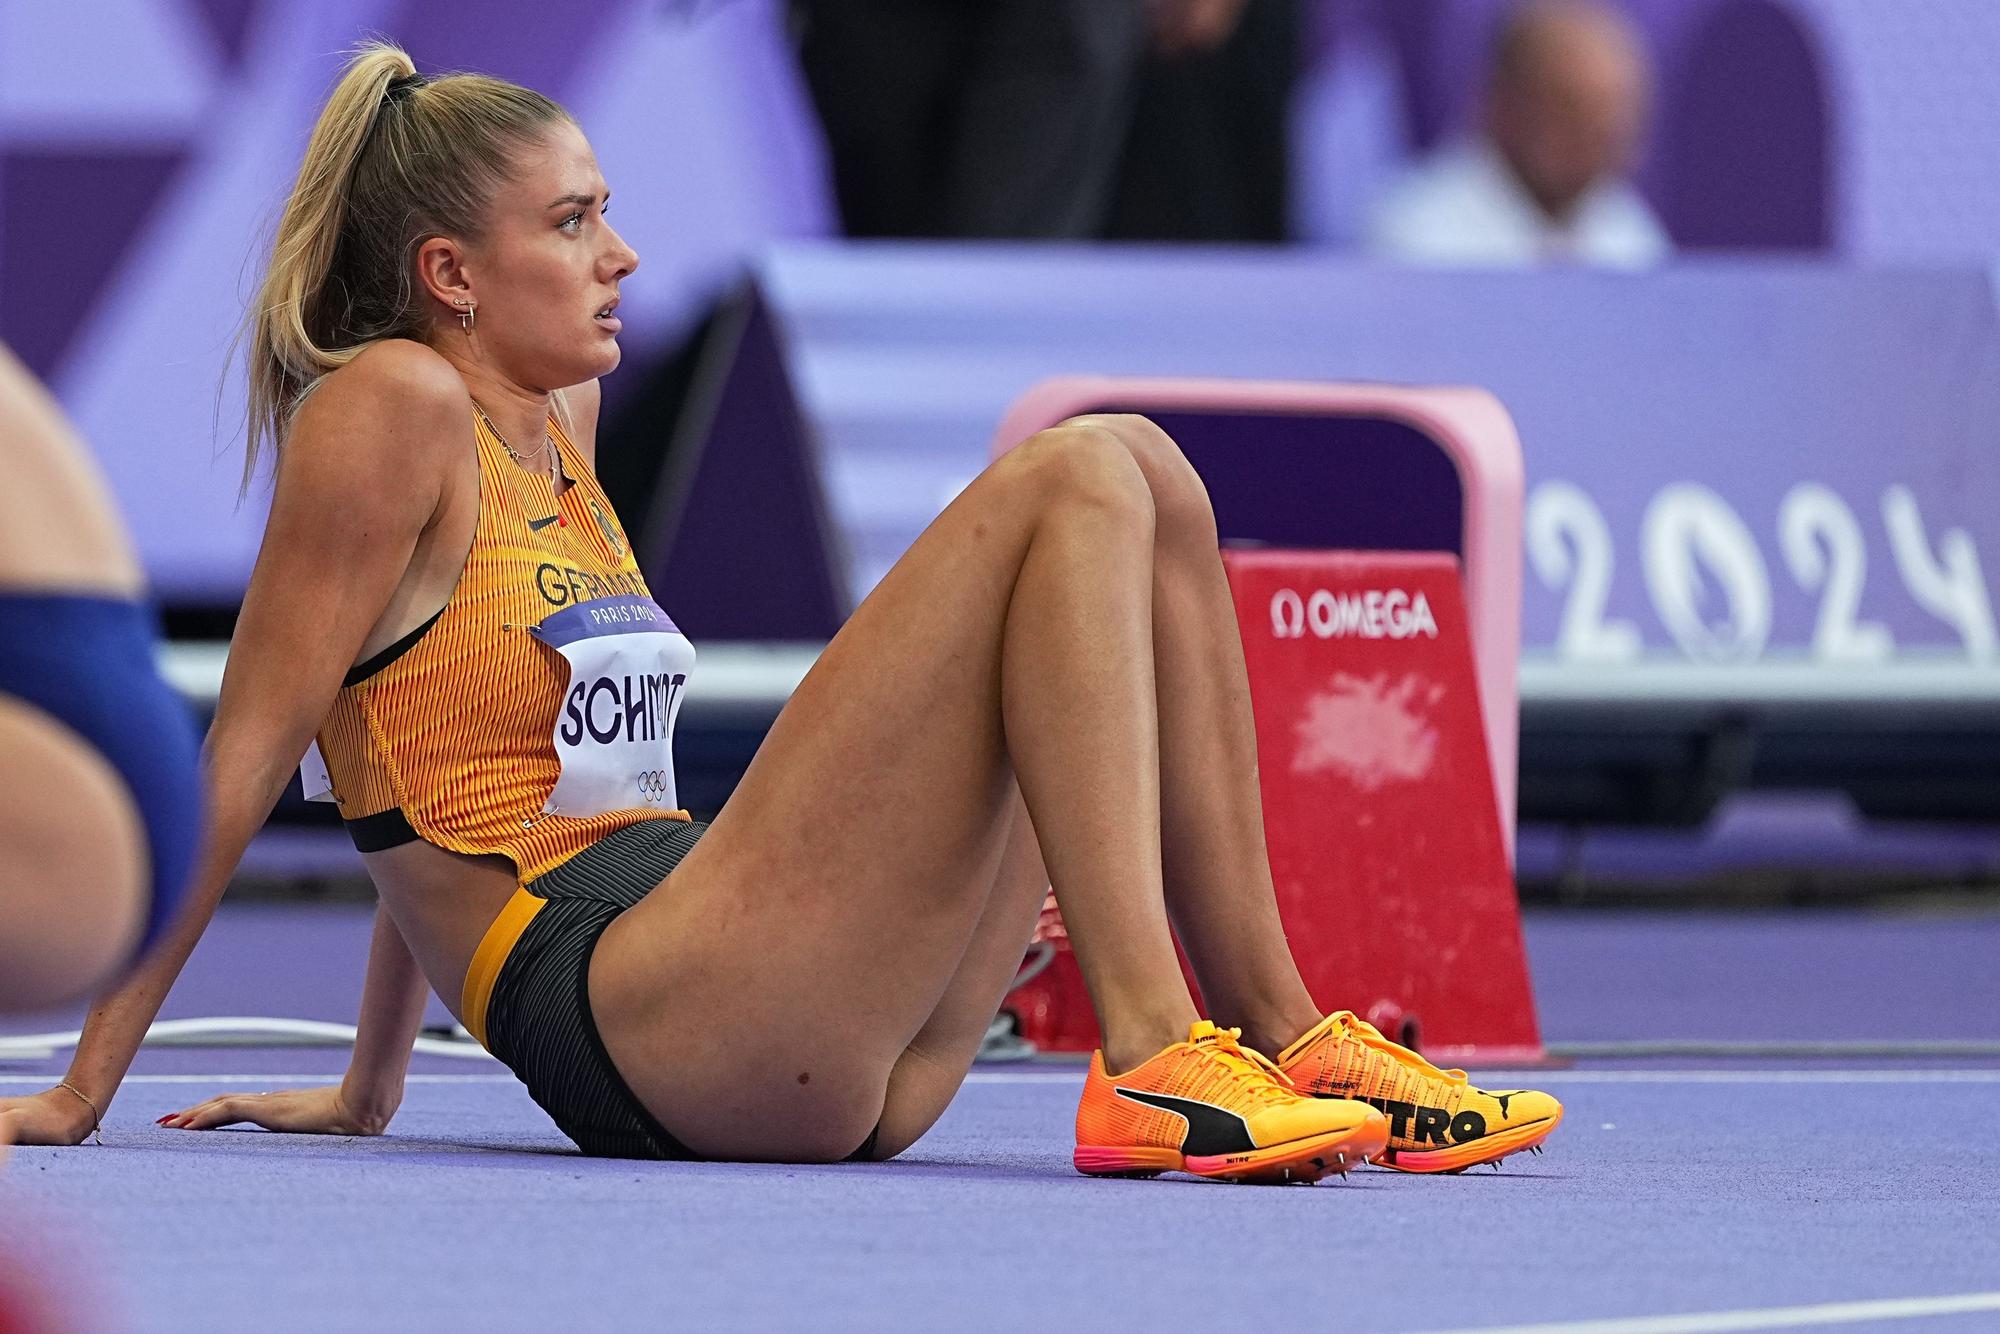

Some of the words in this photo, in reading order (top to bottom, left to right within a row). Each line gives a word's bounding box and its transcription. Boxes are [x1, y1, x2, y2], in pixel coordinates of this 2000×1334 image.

[537, 563, 648, 606] GERMAN
[1525, 480, 2000, 664] 2024
[631, 604, 657, 622] 2024
[1307, 588, 1439, 640] OMEGA
[561, 673, 686, 746] SCHMDT
[1340, 1094, 1486, 1145] TRO
